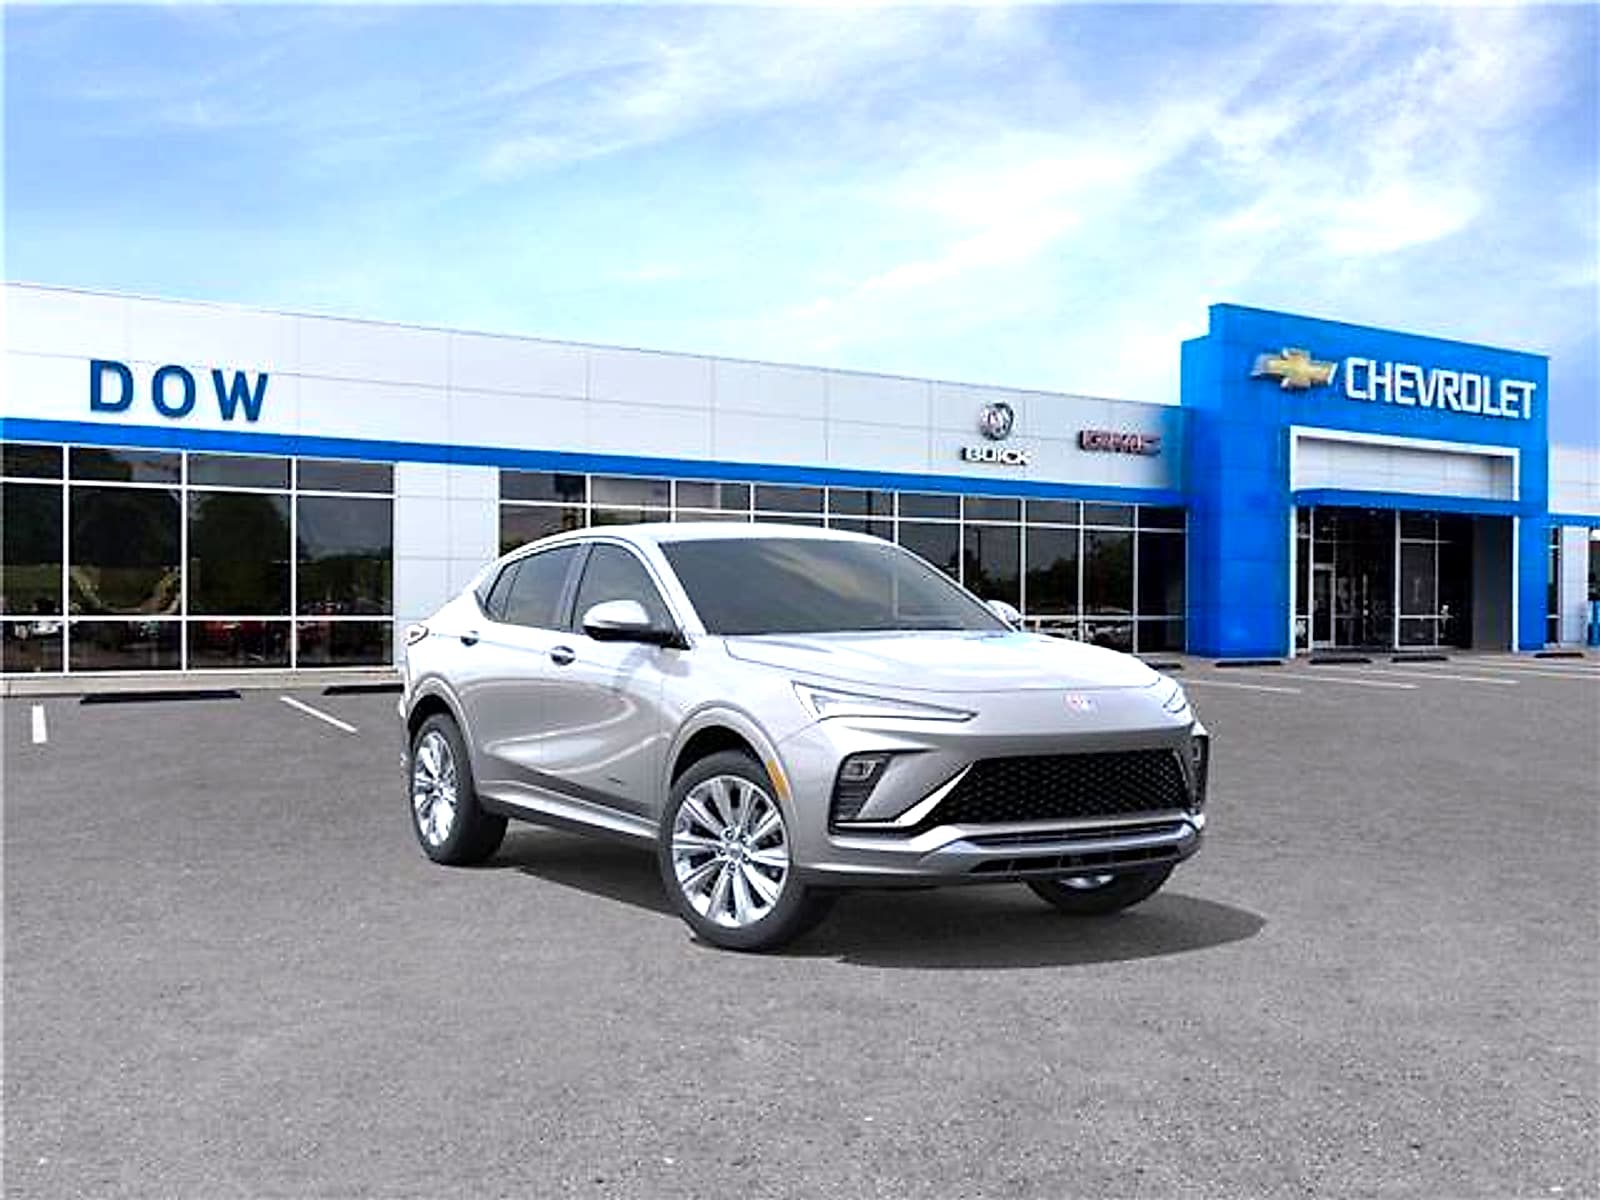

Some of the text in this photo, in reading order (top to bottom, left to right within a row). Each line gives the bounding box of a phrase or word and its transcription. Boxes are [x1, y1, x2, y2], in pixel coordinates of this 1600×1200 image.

[90, 359, 269, 421] DOW
[1346, 357, 1536, 419] CHEVROLET
[961, 447, 1031, 465] BUICK
